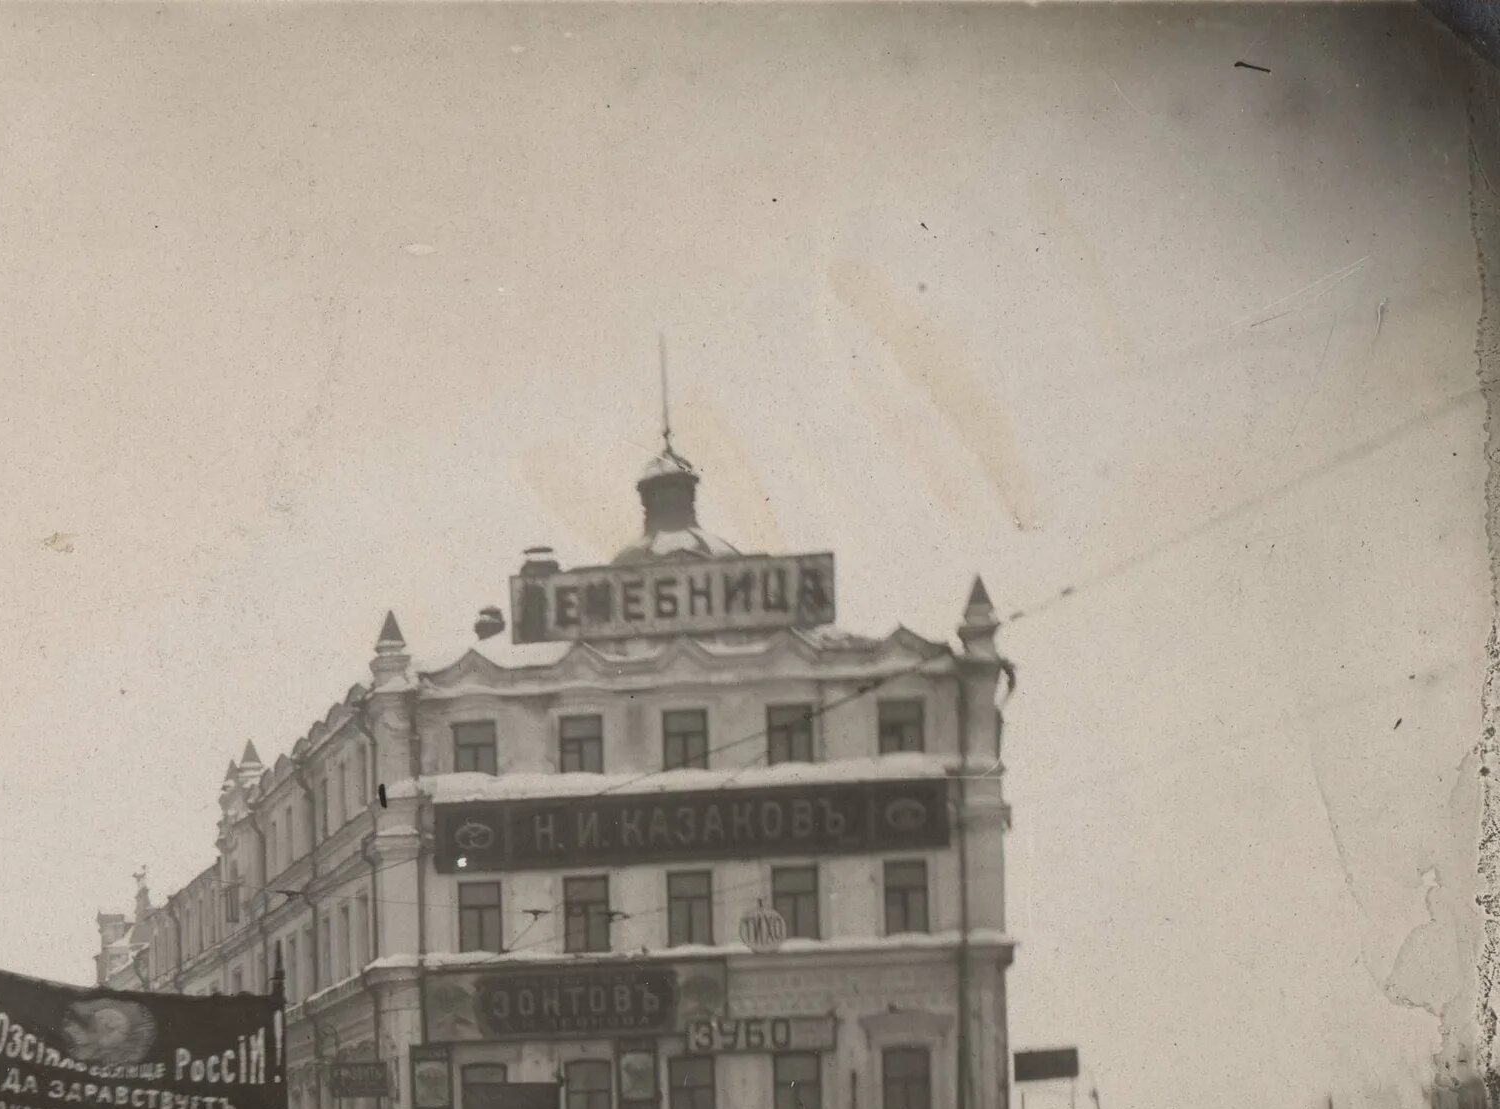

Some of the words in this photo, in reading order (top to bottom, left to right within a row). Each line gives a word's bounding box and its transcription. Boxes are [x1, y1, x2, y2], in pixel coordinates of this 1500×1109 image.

[520, 566, 832, 640] ЕЕБНИЦА
[533, 813, 564, 851] Н.
[577, 810, 609, 849] И.
[621, 797, 846, 848] КАЗАКОВЪ
[0, 1066, 38, 1095] ДА
